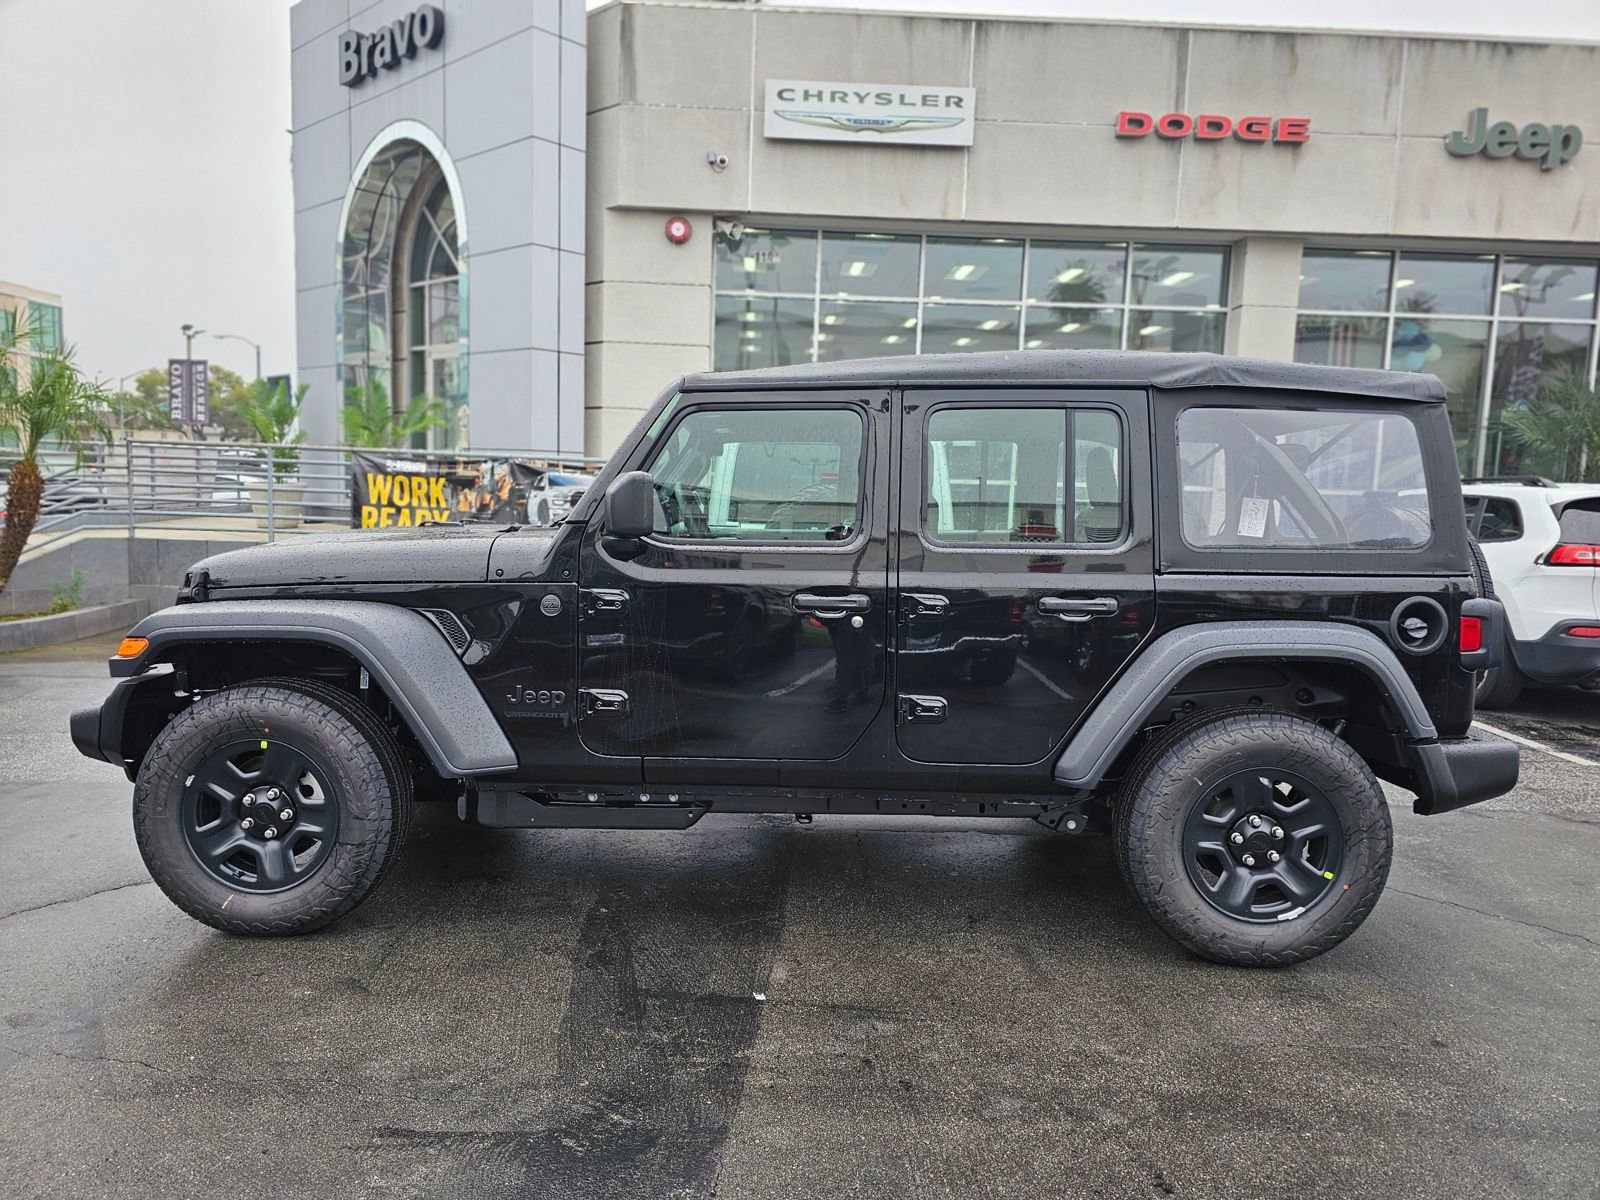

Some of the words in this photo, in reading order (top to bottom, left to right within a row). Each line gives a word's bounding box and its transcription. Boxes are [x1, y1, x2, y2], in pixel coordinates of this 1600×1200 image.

[339, 3, 445, 88] Bravo
[777, 88, 964, 109] CHRYSLER
[1115, 111, 1311, 144] DODGE
[1444, 107, 1583, 171] Jeep
[171, 364, 182, 420] BRAVO
[366, 472, 447, 508] WORK
[506, 685, 566, 709] Jeep
